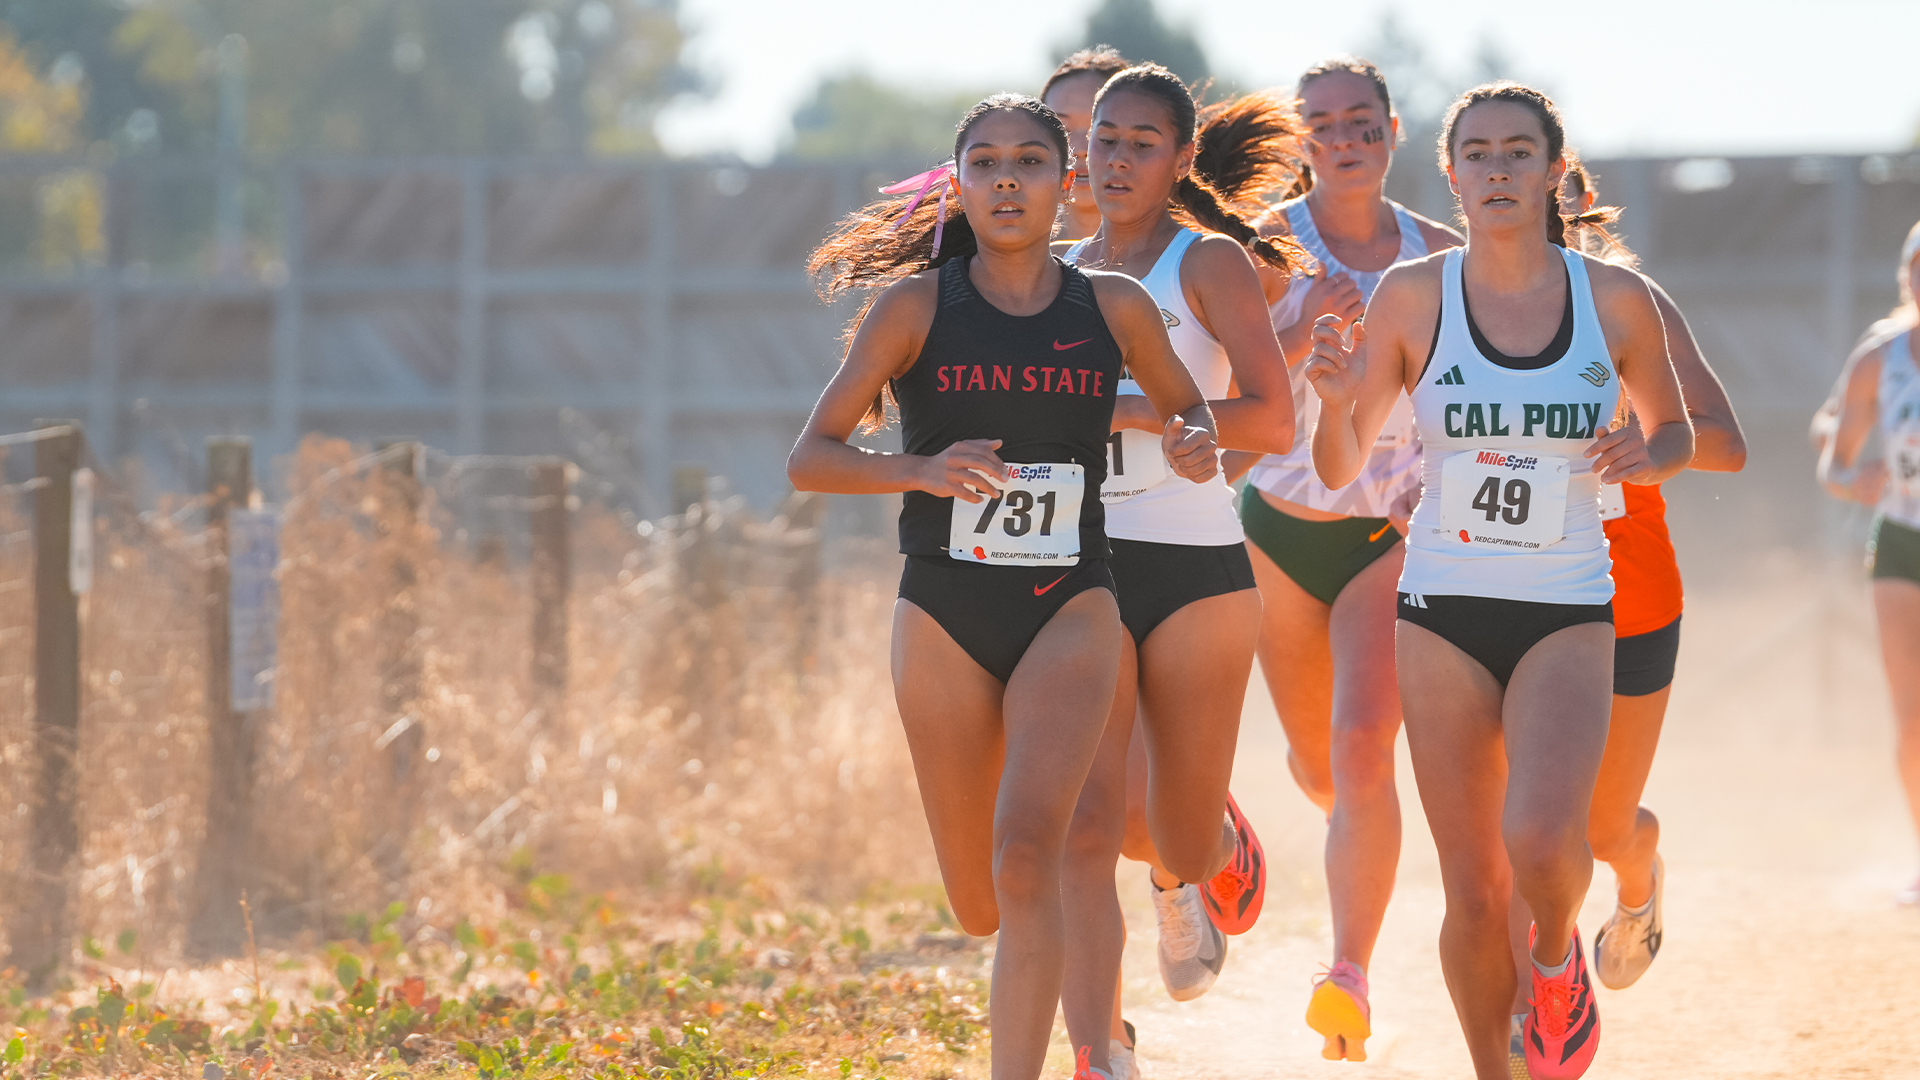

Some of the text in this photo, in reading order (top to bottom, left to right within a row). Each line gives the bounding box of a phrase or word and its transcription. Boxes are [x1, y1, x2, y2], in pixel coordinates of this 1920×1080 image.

[937, 365, 1012, 392] STAN
[1022, 366, 1103, 397] STATE
[1445, 403, 1601, 439] CAL POLY
[1476, 451, 1538, 470] MileSplit
[1004, 465, 1051, 482] leSplit
[973, 487, 1056, 537] 731
[1472, 476, 1531, 525] 49
[1474, 535, 1541, 549] REDCAPTIMING.COM
[991, 551, 1059, 560] REDCAPTIMING.COM
